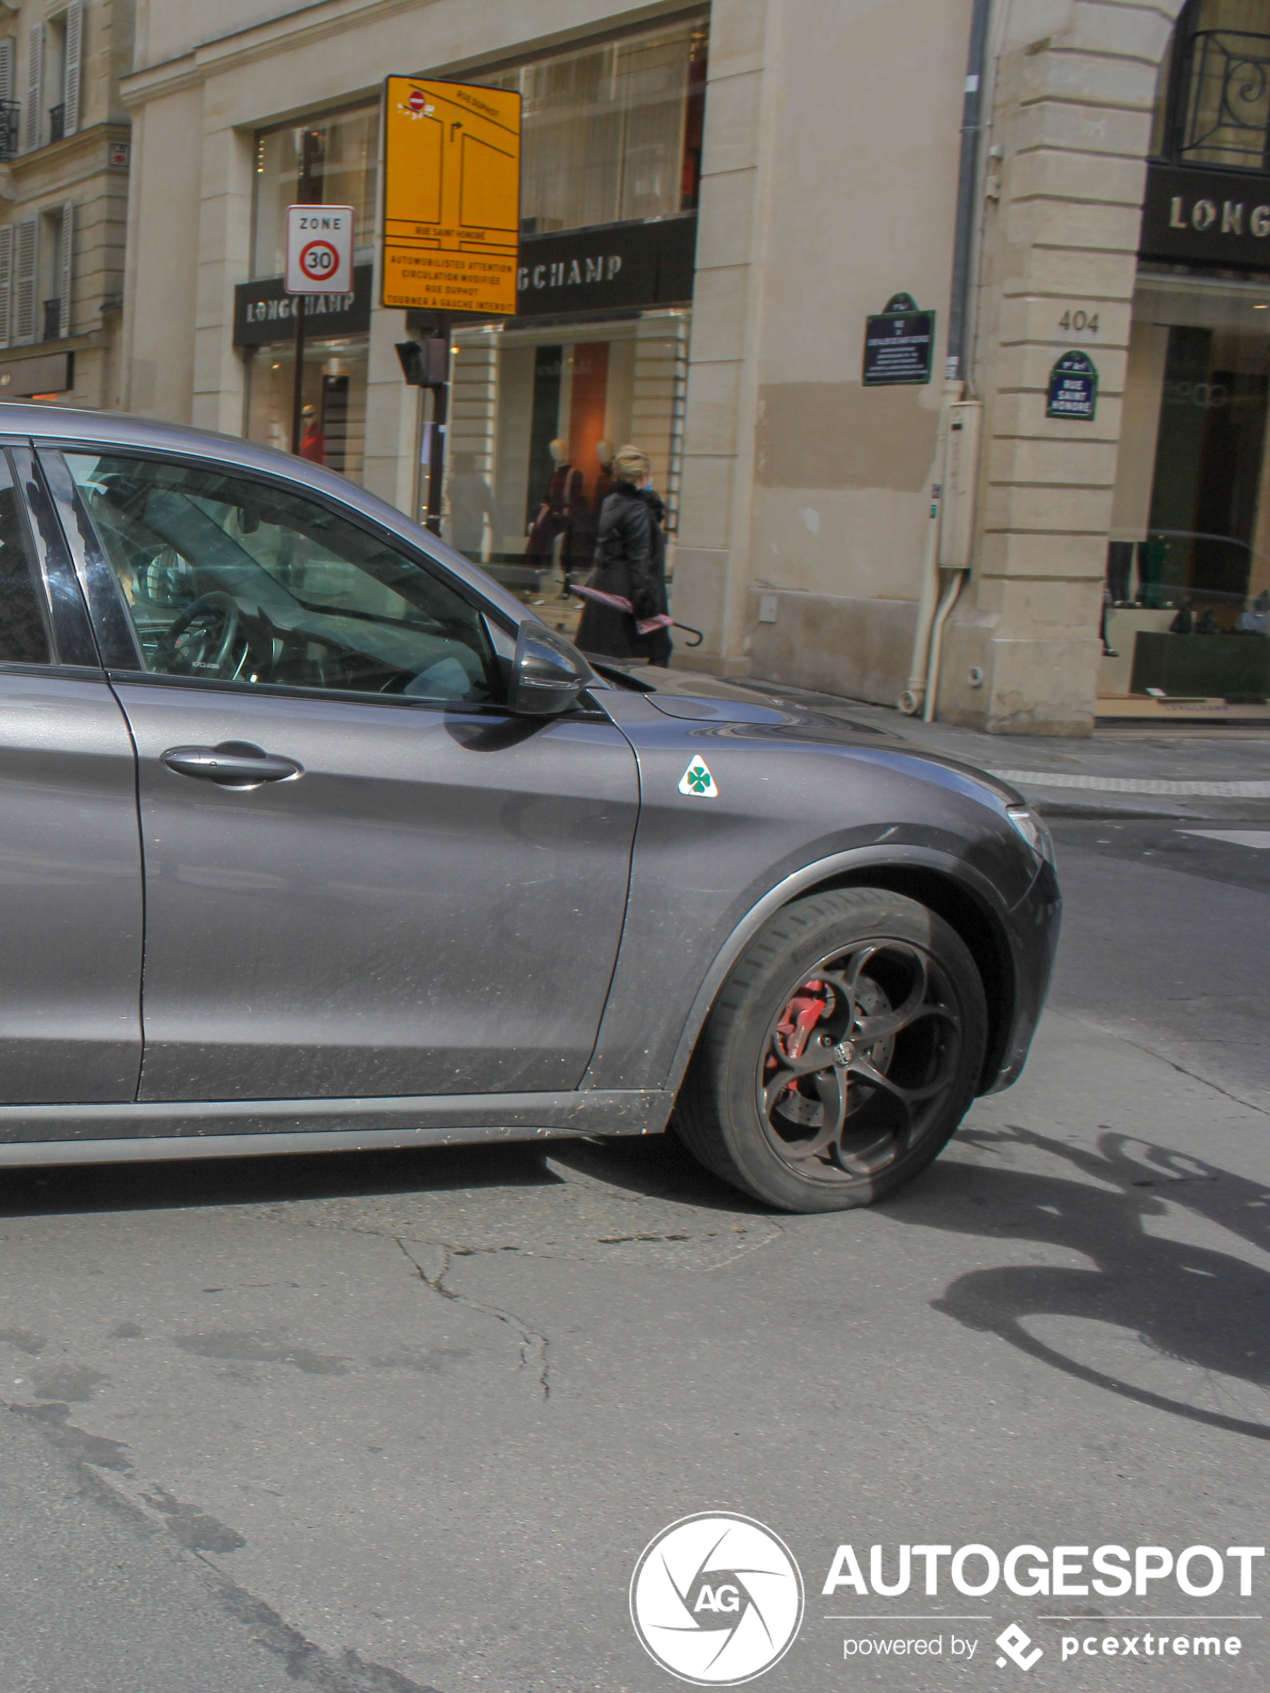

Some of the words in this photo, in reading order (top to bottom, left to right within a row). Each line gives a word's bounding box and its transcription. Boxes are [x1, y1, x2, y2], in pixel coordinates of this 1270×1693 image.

[456, 89, 471, 103] RUE
[472, 98, 500, 118] DUPHOT
[299, 218, 341, 230] ZONE
[1170, 196, 1270, 237] LONG
[415, 226, 432, 236] RUE
[433, 227, 455, 237] SAINT
[307, 251, 332, 269] 30
[390, 255, 465, 269] AUTOMOBILISTES
[468, 261, 513, 273] ATTENTION
[402, 269, 459, 281] CIRCULATION
[461, 273, 501, 285] MODIFIÉE
[425, 284, 442, 294] RUE
[445, 286, 478, 296] DUPHOT
[387, 295, 428, 305] TOURNER
[441, 298, 474, 309] GAUCHE
[475, 301, 513, 312] INTERDIT
[1058, 310, 1099, 333] 404
[1063, 380, 1084, 390] RUE
[1057, 390, 1087, 400] SAINT
